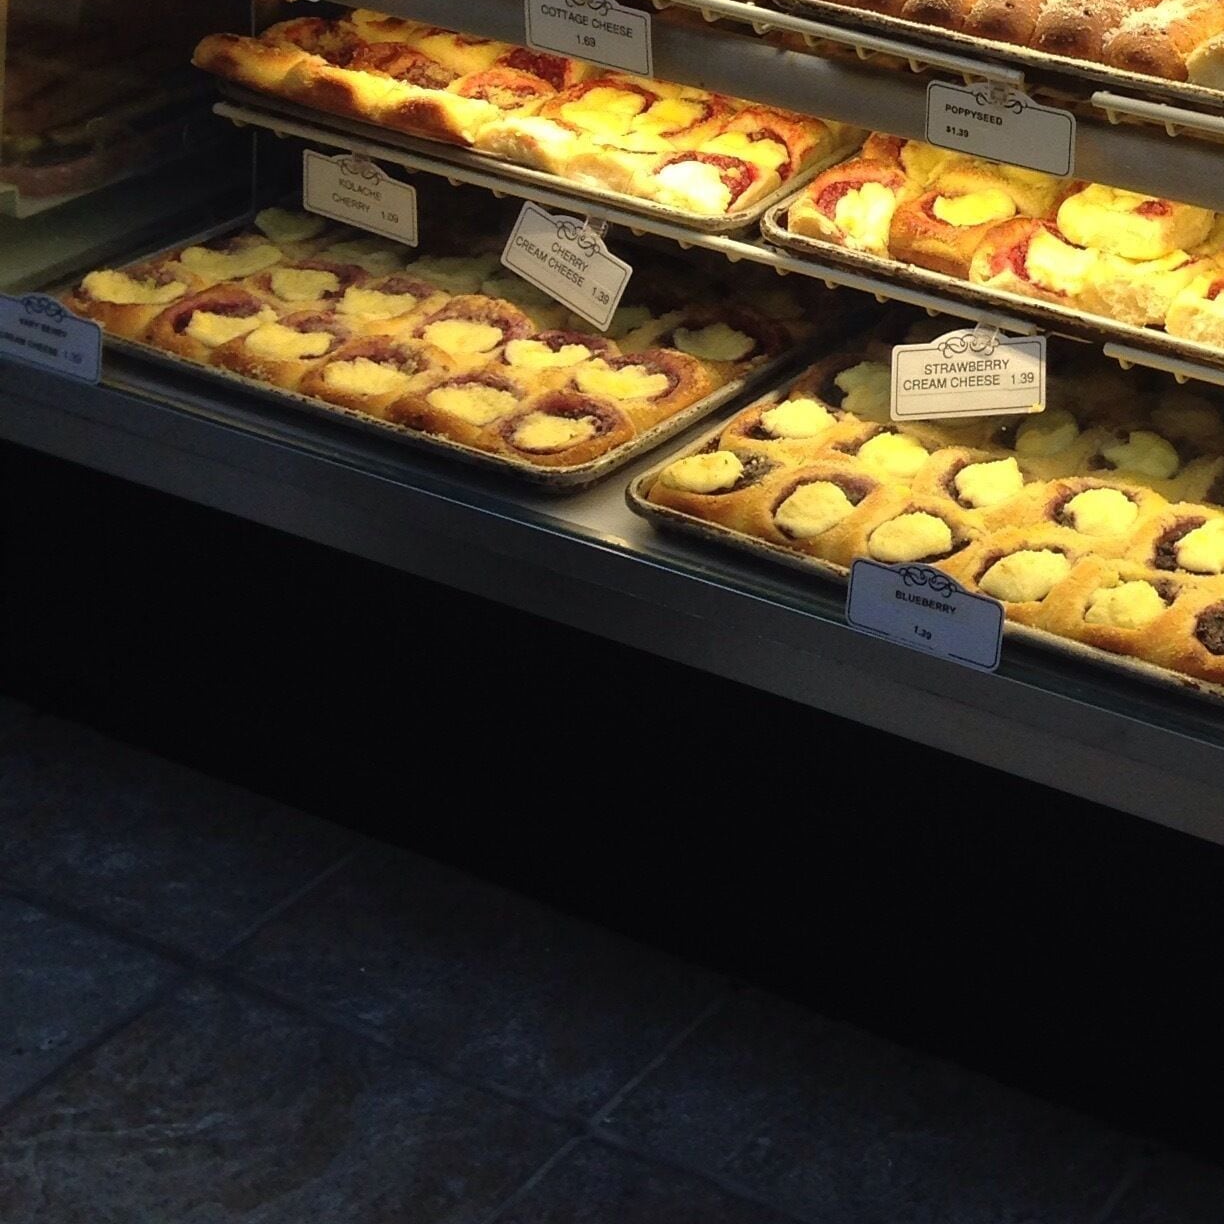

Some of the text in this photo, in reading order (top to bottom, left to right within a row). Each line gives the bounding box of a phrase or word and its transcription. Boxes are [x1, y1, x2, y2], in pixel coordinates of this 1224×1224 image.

[540, 4, 633, 39] COTTAGE CHEESE
[945, 103, 1003, 126] POPPYSEED
[515, 235, 549, 263] CREAM
[548, 257, 585, 288] CHEESE
[551, 241, 589, 272] CHERRY
[924, 359, 1010, 375] STRAWBERRY
[903, 372, 1035, 391] CREAM CHEESE 1.39
[895, 589, 957, 615] BLUEBERRY
